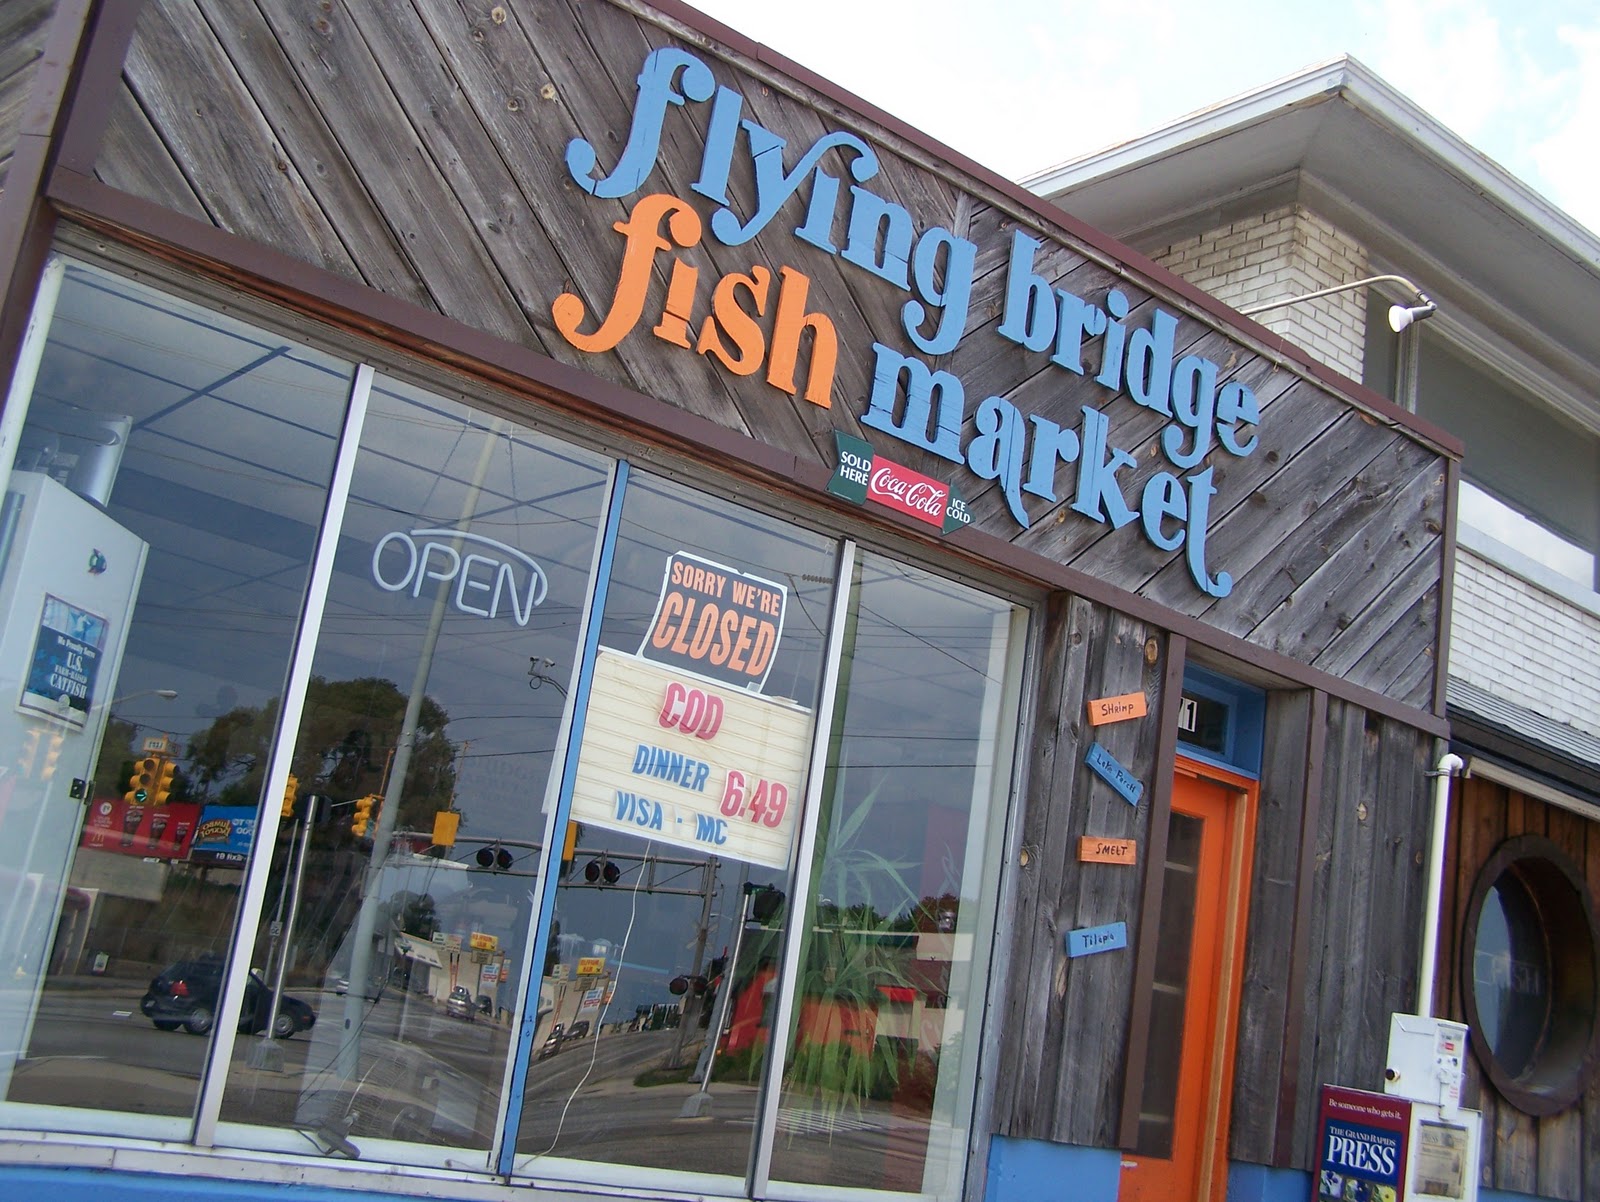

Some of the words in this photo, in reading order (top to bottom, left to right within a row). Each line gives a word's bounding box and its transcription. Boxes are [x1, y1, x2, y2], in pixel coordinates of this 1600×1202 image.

[565, 46, 977, 355] flying
[998, 229, 1260, 469] bridge
[552, 193, 838, 409] fish
[860, 342, 1232, 598] market
[840, 465, 869, 486] HERE
[841, 451, 872, 472] SOLD
[946, 506, 971, 524] COLD
[952, 498, 966, 512] ICE
[372, 531, 539, 627] OPEN
[671, 561, 727, 599] SORRY
[732, 580, 781, 617] WE'RE
[652, 591, 776, 676] CLOSED
[50, 673, 87, 699] CATFISH
[658, 682, 725, 741] COD
[631, 745, 710, 793] DINNER
[615, 791, 662, 831] VISA
[696, 814, 728, 845] MC
[719, 770, 788, 829] 6.49
[1096, 843, 1127, 855] SMELT
[1328, 1098, 1338, 1107] Be
[1338, 1102, 1366, 1113] someone
[1366, 1106, 1381, 1116] who
[1380, 1110, 1394, 1119] gets
[1326, 1134, 1396, 1175] PRESS
[1330, 1126, 1345, 1136] THE
[1345, 1129, 1370, 1141] GRAND
[1370, 1134, 1397, 1146] RAPIDS
